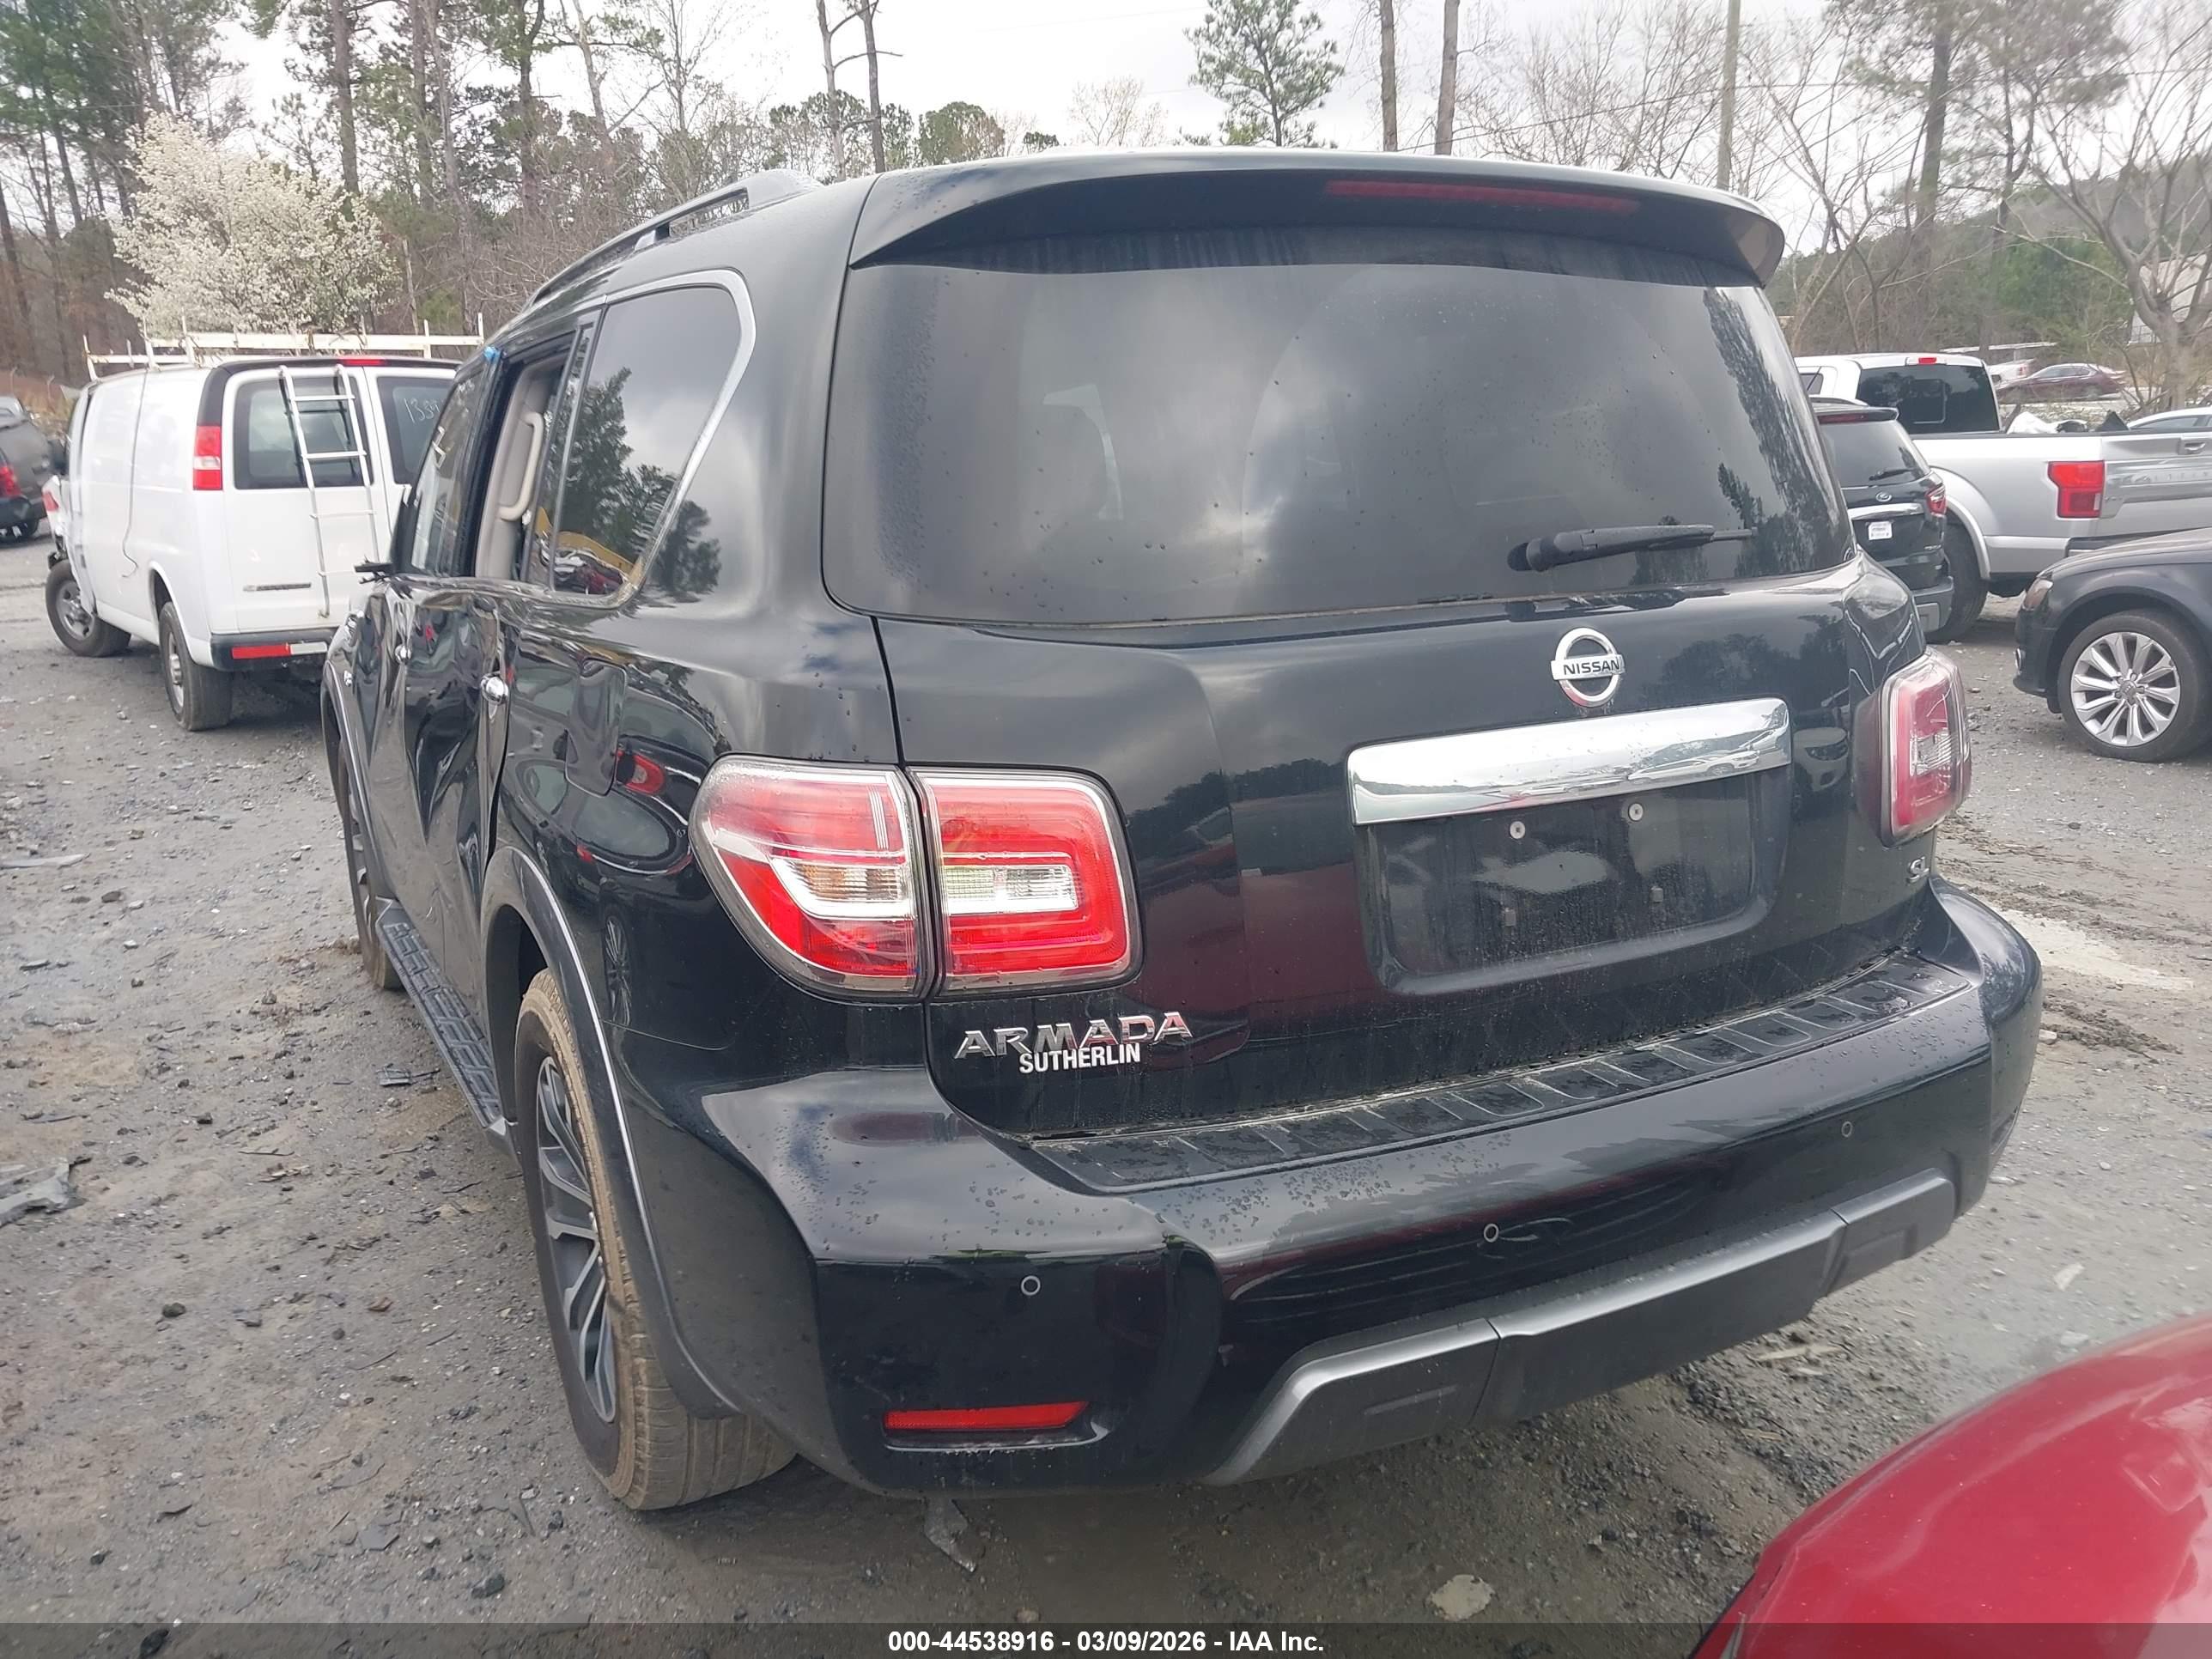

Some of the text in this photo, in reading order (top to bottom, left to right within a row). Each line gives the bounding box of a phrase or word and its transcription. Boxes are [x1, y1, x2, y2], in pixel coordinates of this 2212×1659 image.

[1563, 659, 1620, 676] NISSAN
[953, 1011, 1194, 1060] ARMADA
[1018, 1042, 1141, 1074] SUTHERLIN
